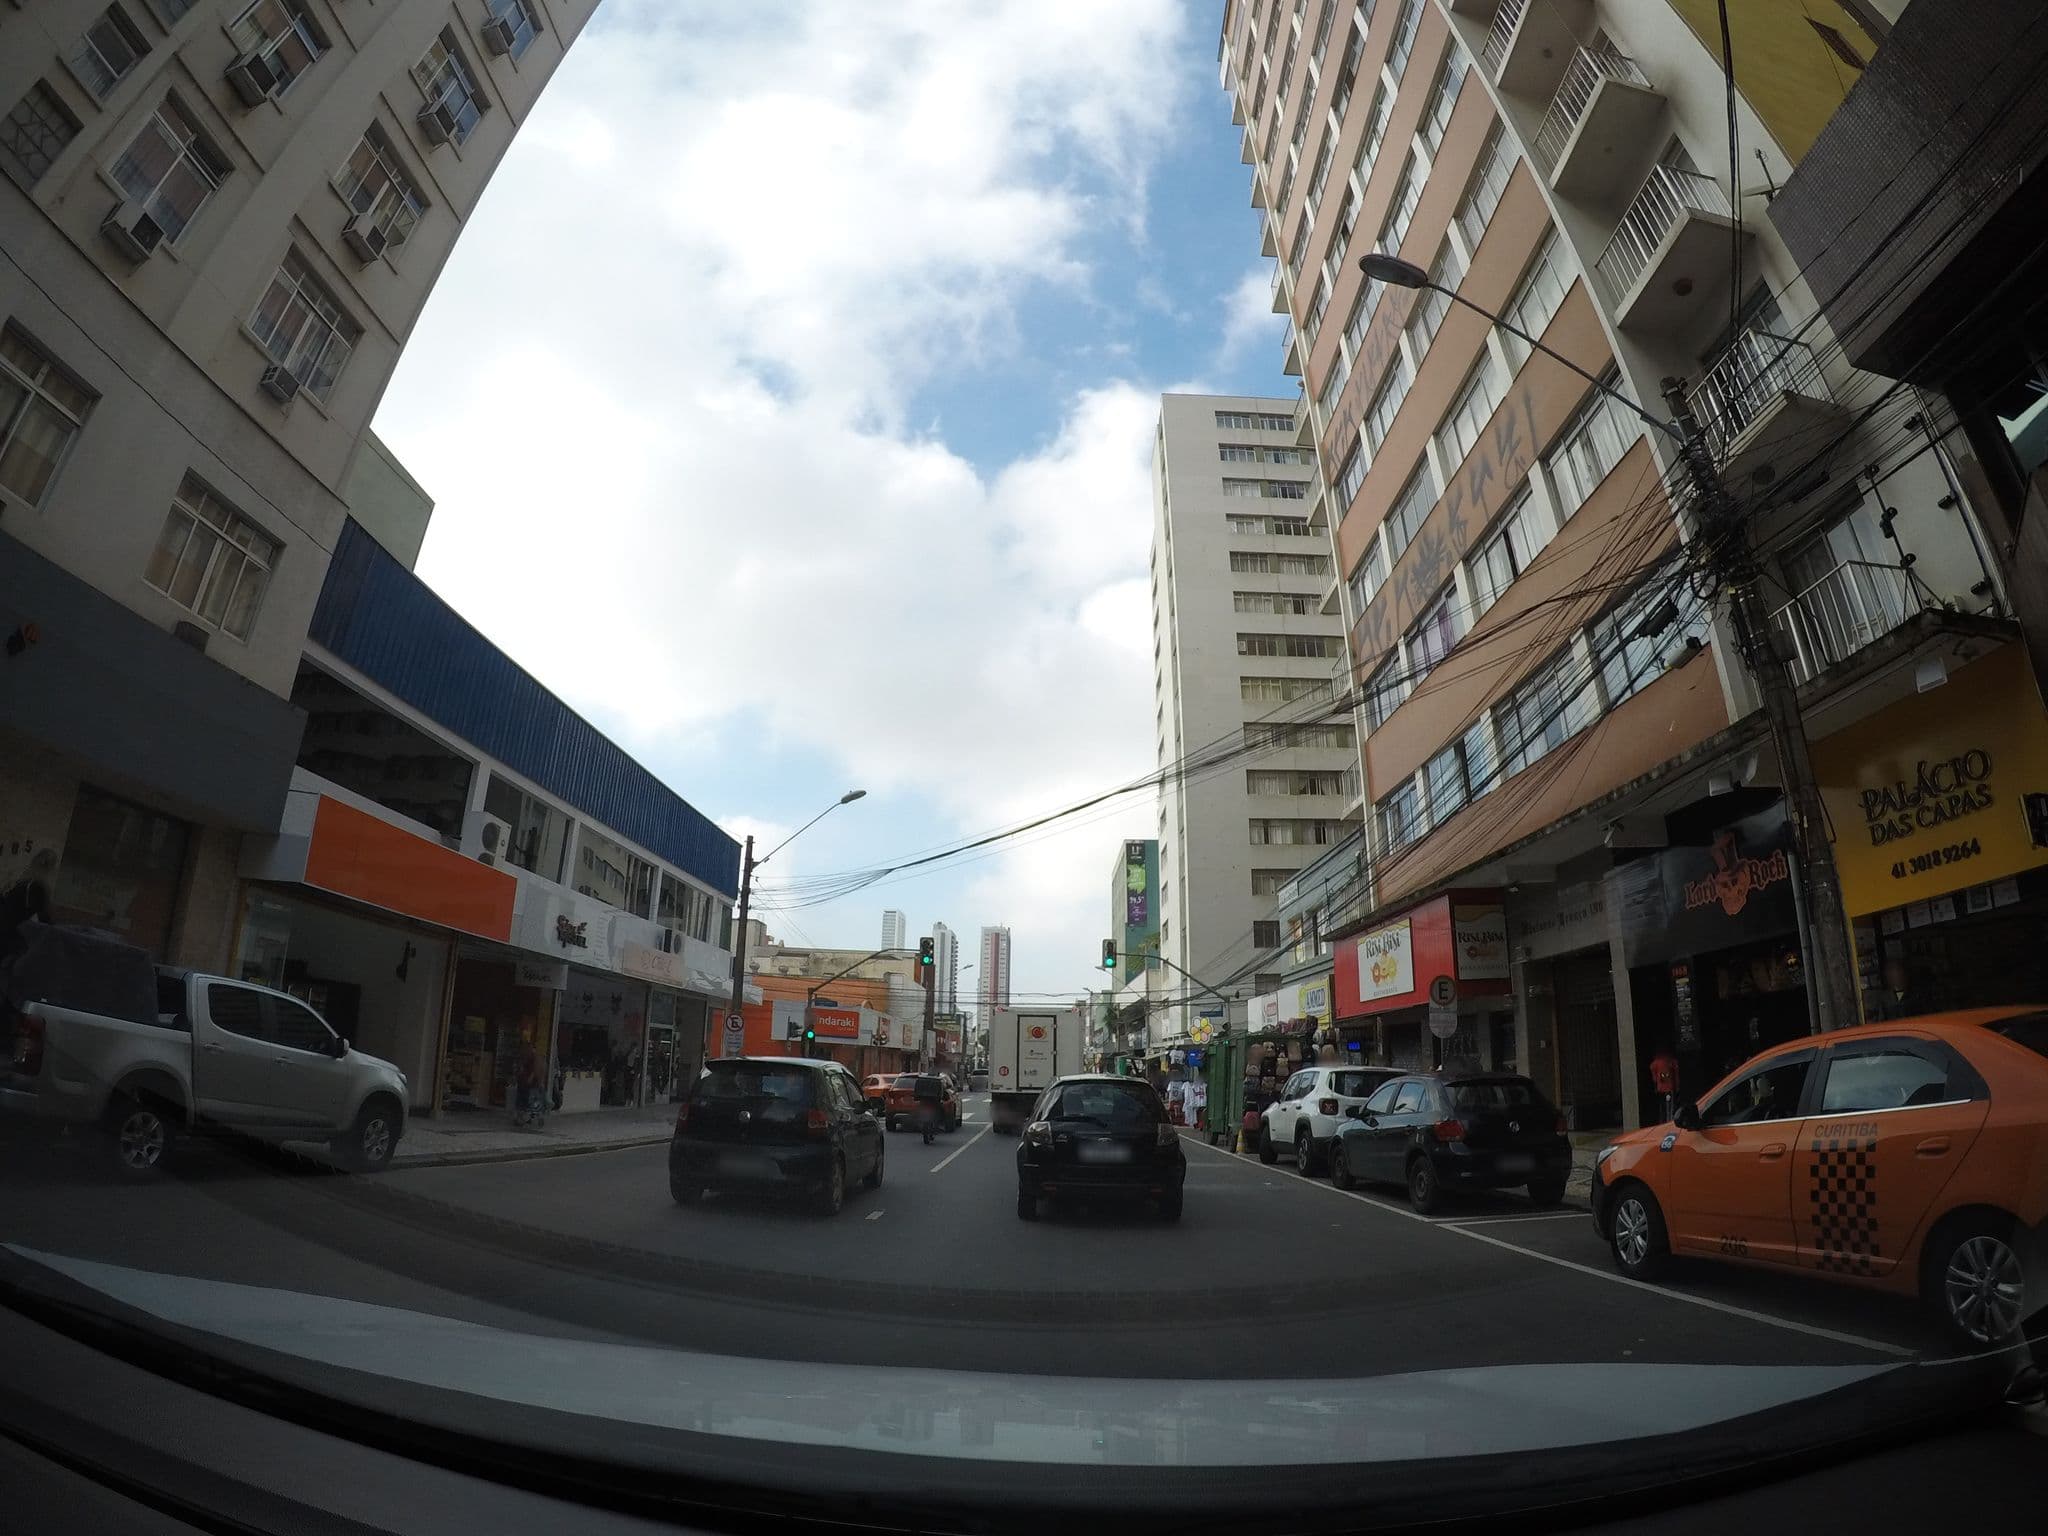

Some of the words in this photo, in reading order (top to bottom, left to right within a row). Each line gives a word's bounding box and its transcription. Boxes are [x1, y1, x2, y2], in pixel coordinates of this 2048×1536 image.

[1869, 813, 1914, 846] DAS
[1916, 784, 1994, 829] CAPAS
[1749, 849, 1788, 891] Rock
[1891, 862, 1906, 879] 41
[1909, 850, 1941, 874] 3018
[1942, 838, 1981, 865] 9264
[1438, 981, 1448, 1000] E
[1814, 1122, 1878, 1139] CURITIBA
